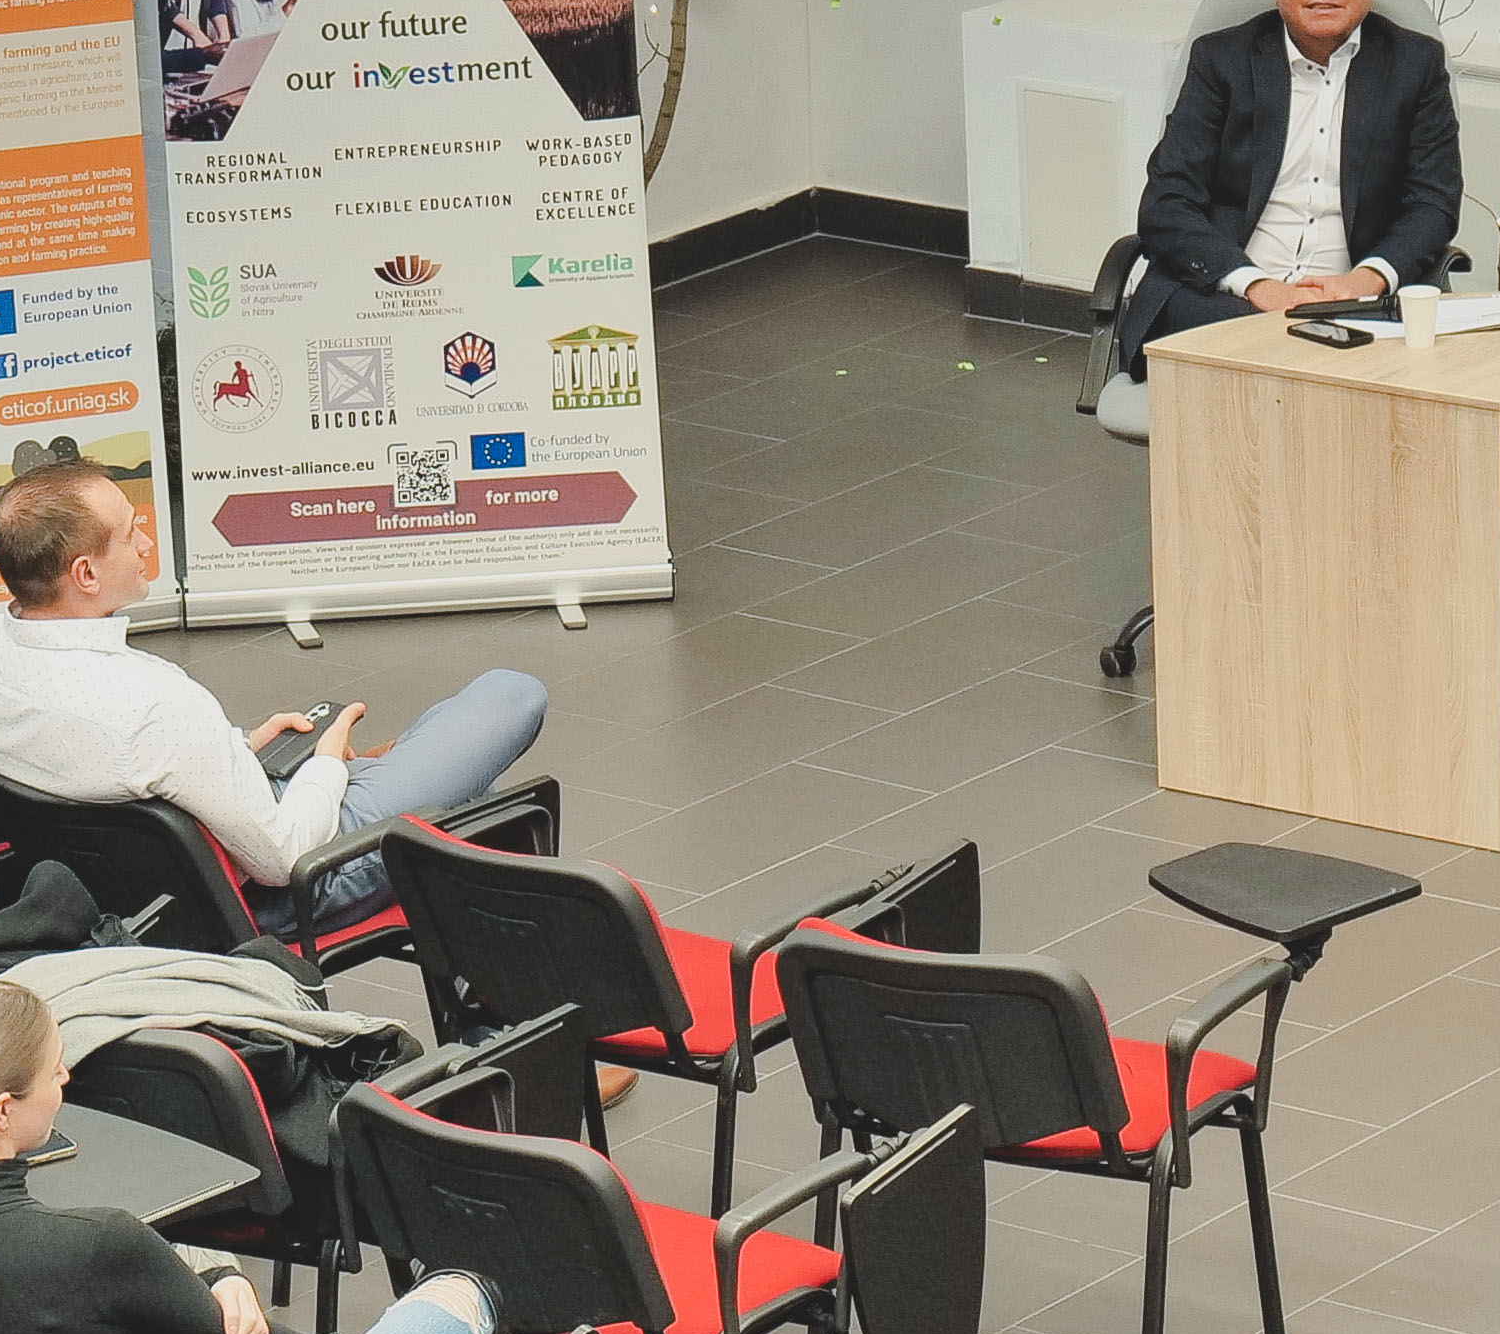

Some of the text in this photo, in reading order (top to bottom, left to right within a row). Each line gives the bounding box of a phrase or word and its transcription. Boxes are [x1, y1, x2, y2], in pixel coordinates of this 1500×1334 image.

[321, 12, 466, 40] our future
[286, 56, 532, 90] our investment
[334, 140, 500, 160] ENTREPRENEURSHIP
[526, 133, 630, 150] WORK-BASED
[207, 152, 286, 167] REGIONAL
[539, 151, 621, 166] PEDAGOGY
[174, 166, 321, 184] TRANSFORMATION
[542, 186, 628, 203] CENTRE OF
[336, 194, 510, 215] FLEXIBLE EDUCATION
[536, 202, 635, 220] EXCELLENCE
[186, 207, 291, 223] ECOSYSTEMS
[548, 253, 632, 274] Karelia
[22, 285, 117, 304] Funded by the
[24, 302, 131, 323] European Union
[23, 343, 131, 372] project.eticof
[2, 386, 130, 419] eticof.uniag.sk
[311, 409, 396, 429] BICOCCA
[530, 433, 609, 447] Co-funded by
[532, 447, 646, 462] the European Union
[192, 461, 373, 480] www.invest-alliance.eu
[485, 489, 558, 504] for more
[290, 499, 375, 516] Scan here
[376, 510, 476, 529] information
